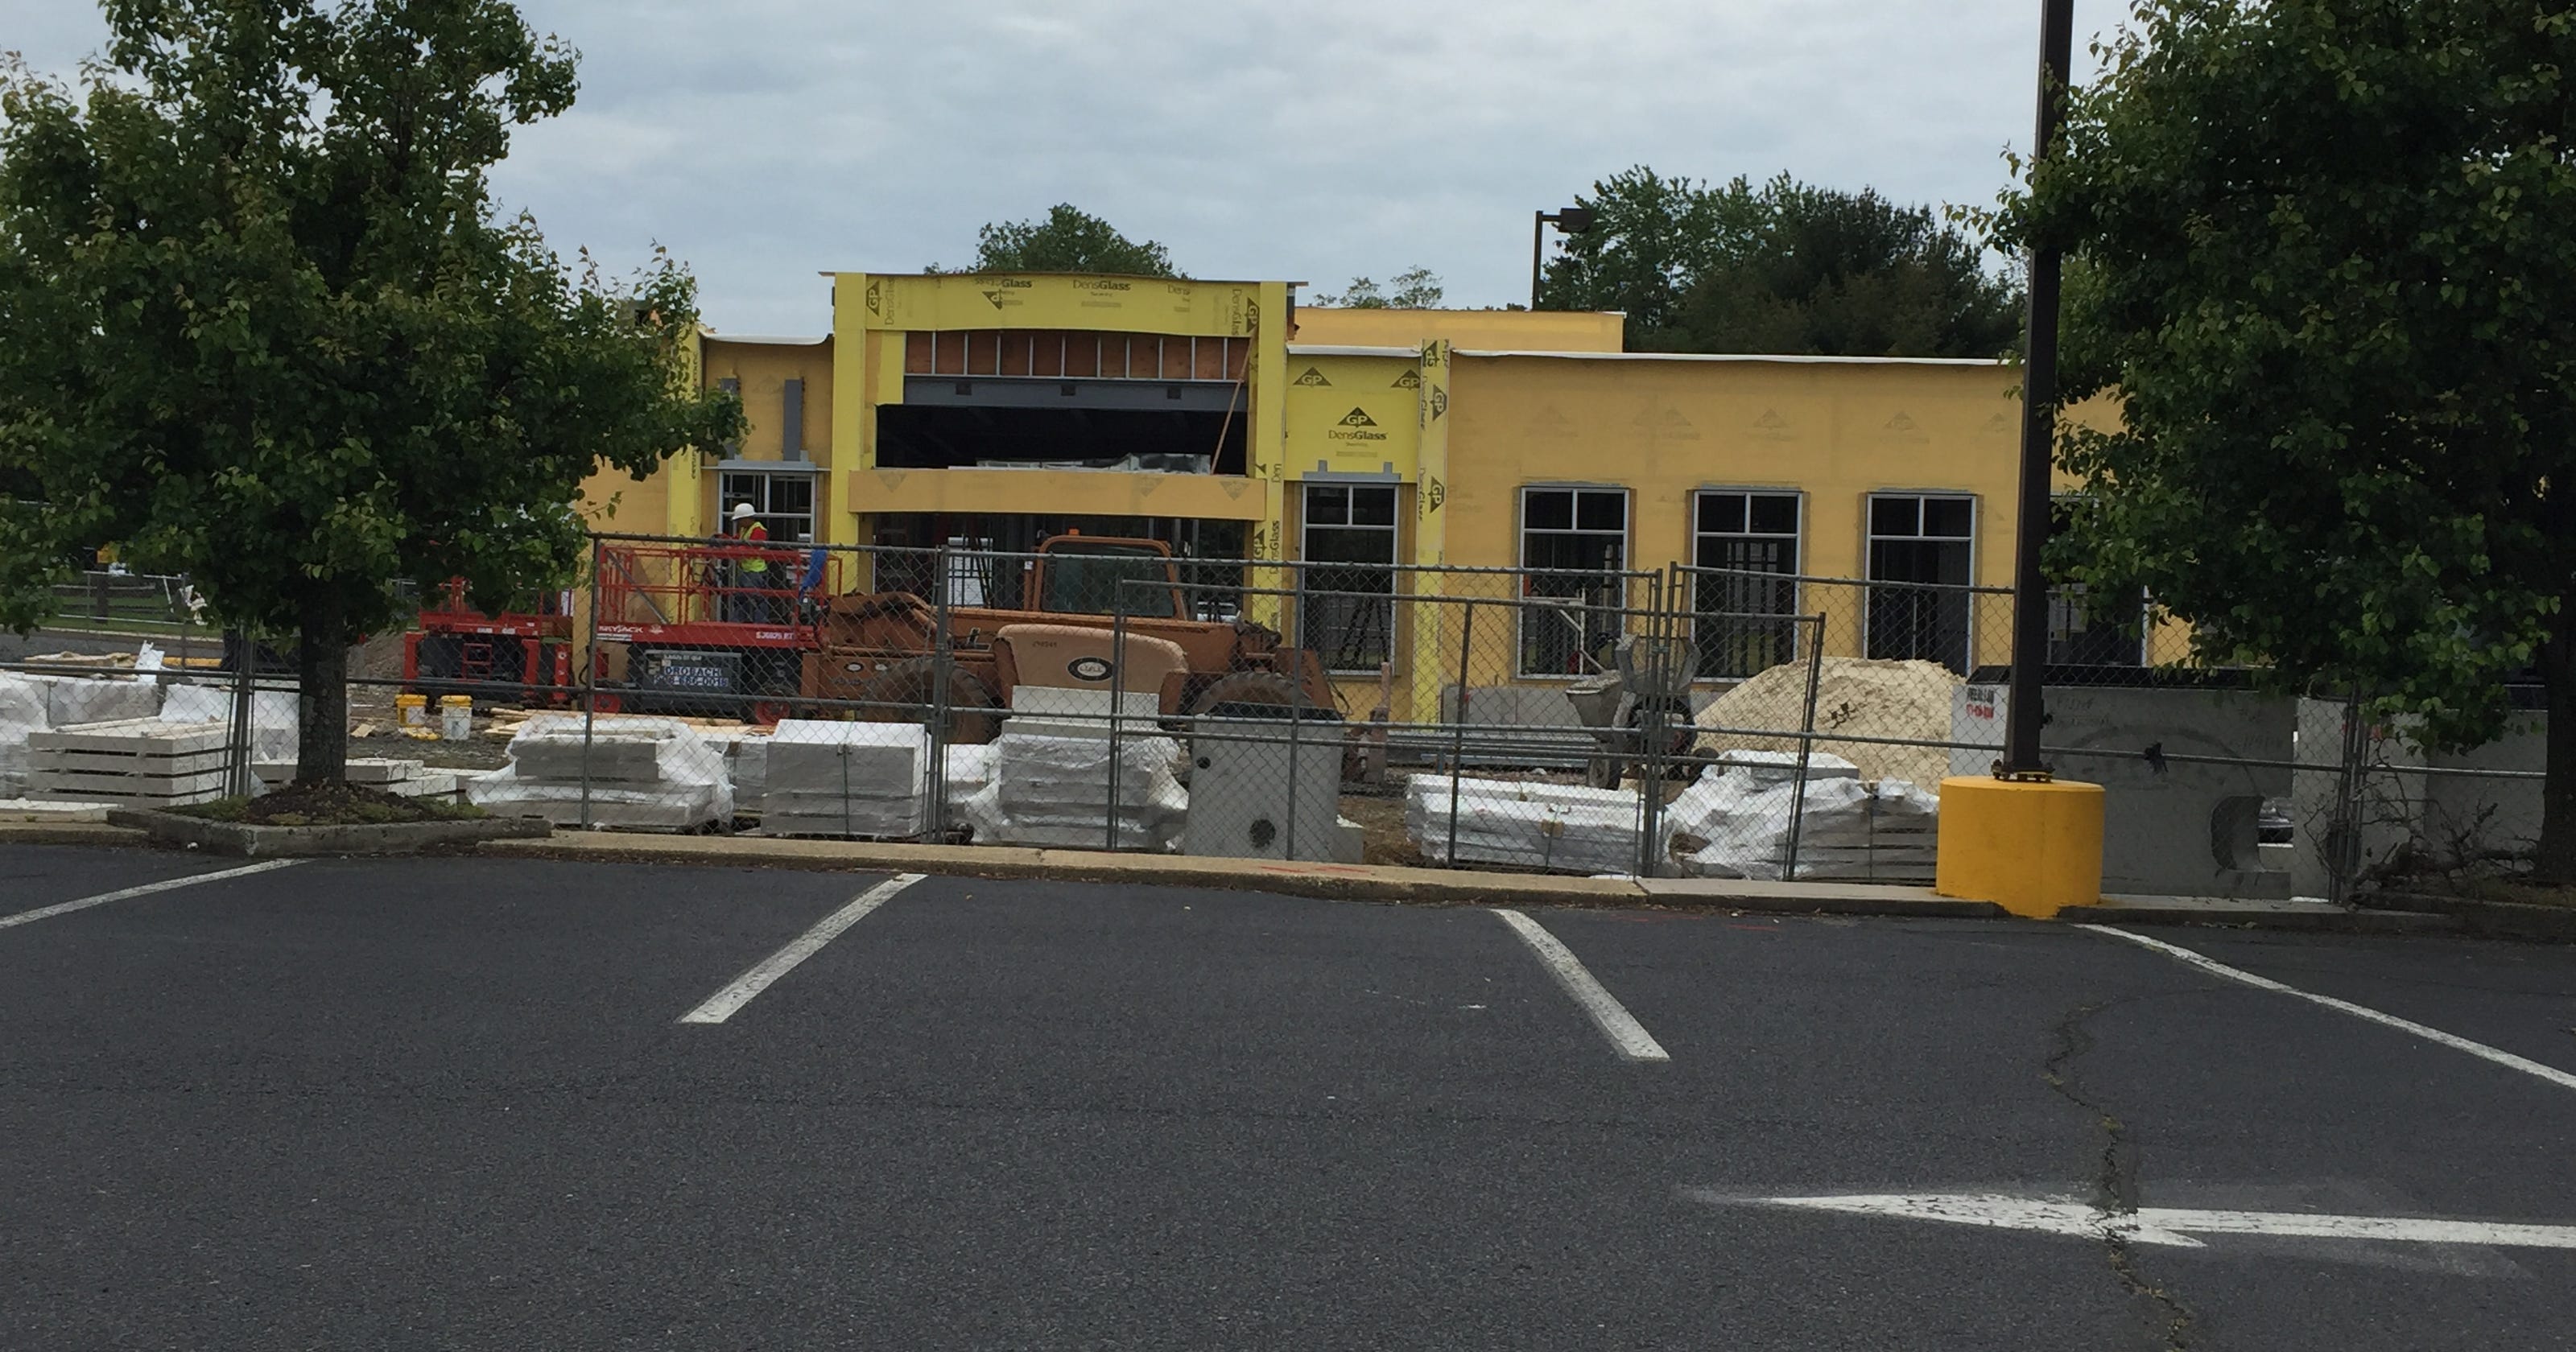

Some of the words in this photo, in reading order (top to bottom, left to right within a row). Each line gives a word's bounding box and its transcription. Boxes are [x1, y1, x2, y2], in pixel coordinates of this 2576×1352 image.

[1002, 278, 1032, 288] Glass
[1072, 279, 1131, 291] DensGlass
[869, 291, 879, 308] GP
[1301, 375, 1323, 385] GP
[1398, 377, 1420, 387] GP
[1434, 392, 1444, 413] GP
[1346, 415, 1368, 425] GP
[1328, 430, 1387, 440] DensGlass
[1432, 484, 1443, 505] GP
[1253, 538, 1265, 559] GP
